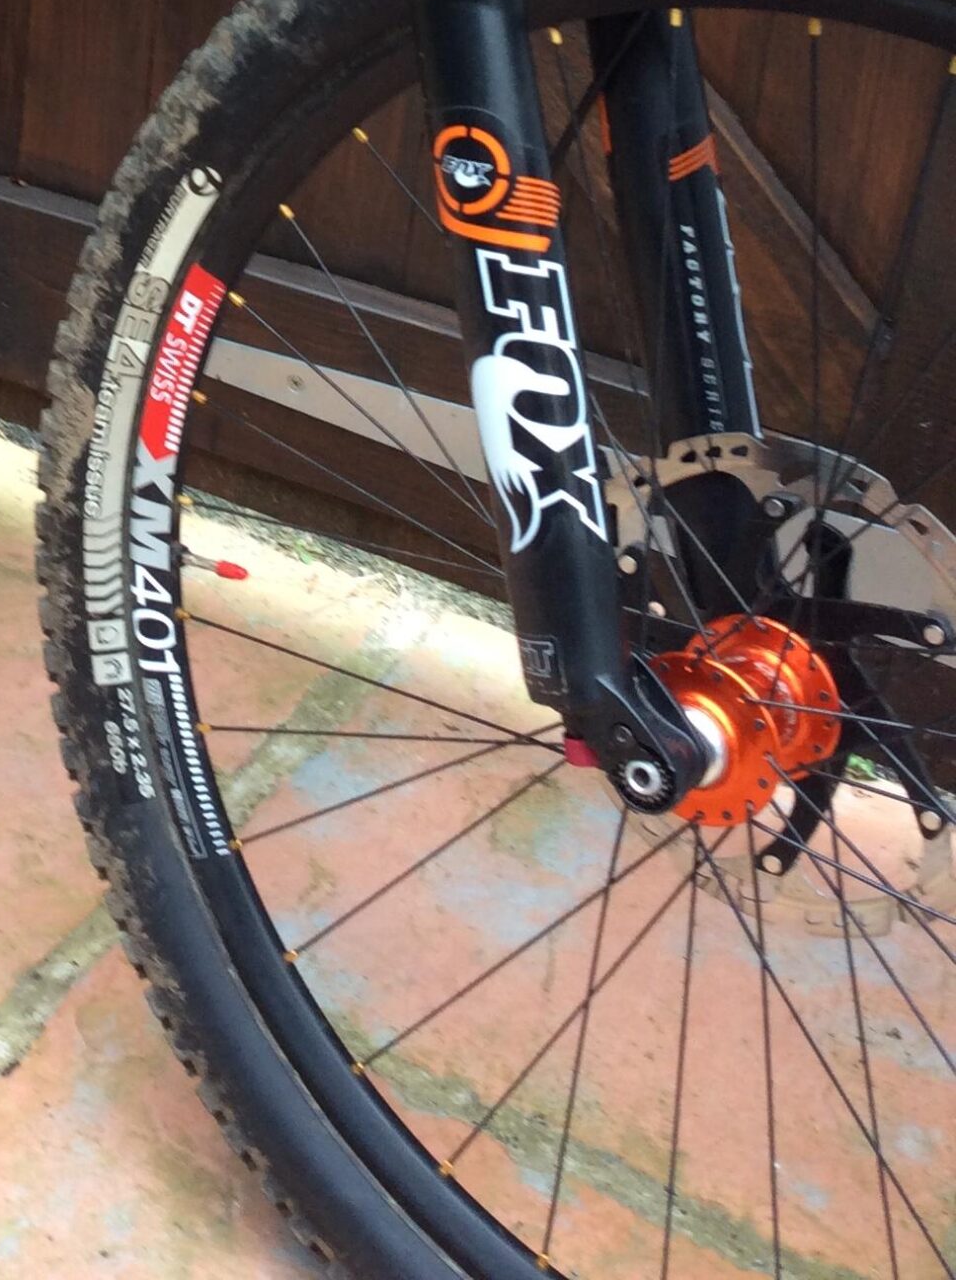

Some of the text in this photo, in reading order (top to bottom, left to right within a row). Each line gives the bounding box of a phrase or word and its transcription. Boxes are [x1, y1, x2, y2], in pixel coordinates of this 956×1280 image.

[441, 154, 495, 188] FOX
[107, 272, 171, 380] SE4
[150, 290, 204, 406] DT SWISS
[680, 224, 725, 434] FACTORY SERIE
[471, 248, 609, 554] FOX
[83, 449, 110, 518] issue
[129, 437, 182, 676] XM401
[116, 687, 141, 733] 27.5
[129, 751, 157, 799] 2.35
